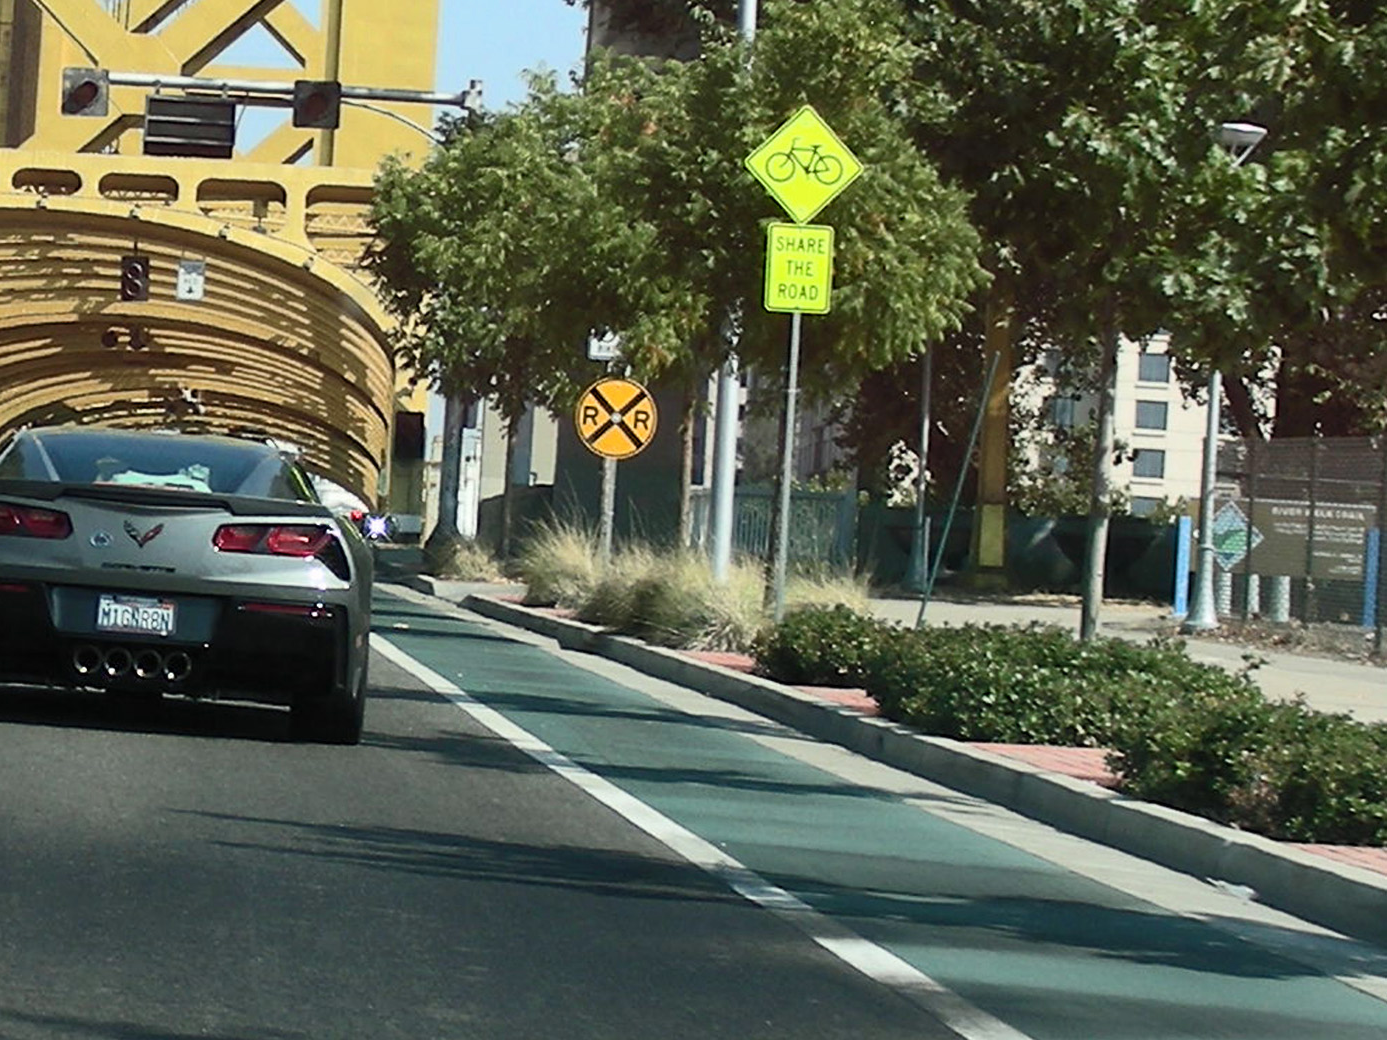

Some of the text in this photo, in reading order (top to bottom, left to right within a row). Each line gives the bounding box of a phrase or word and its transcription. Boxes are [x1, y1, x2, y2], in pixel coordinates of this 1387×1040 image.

[776, 236, 826, 254] SHARE
[787, 260, 814, 277] THE
[778, 283, 819, 301] ROAD
[582, 406, 651, 430] R R
